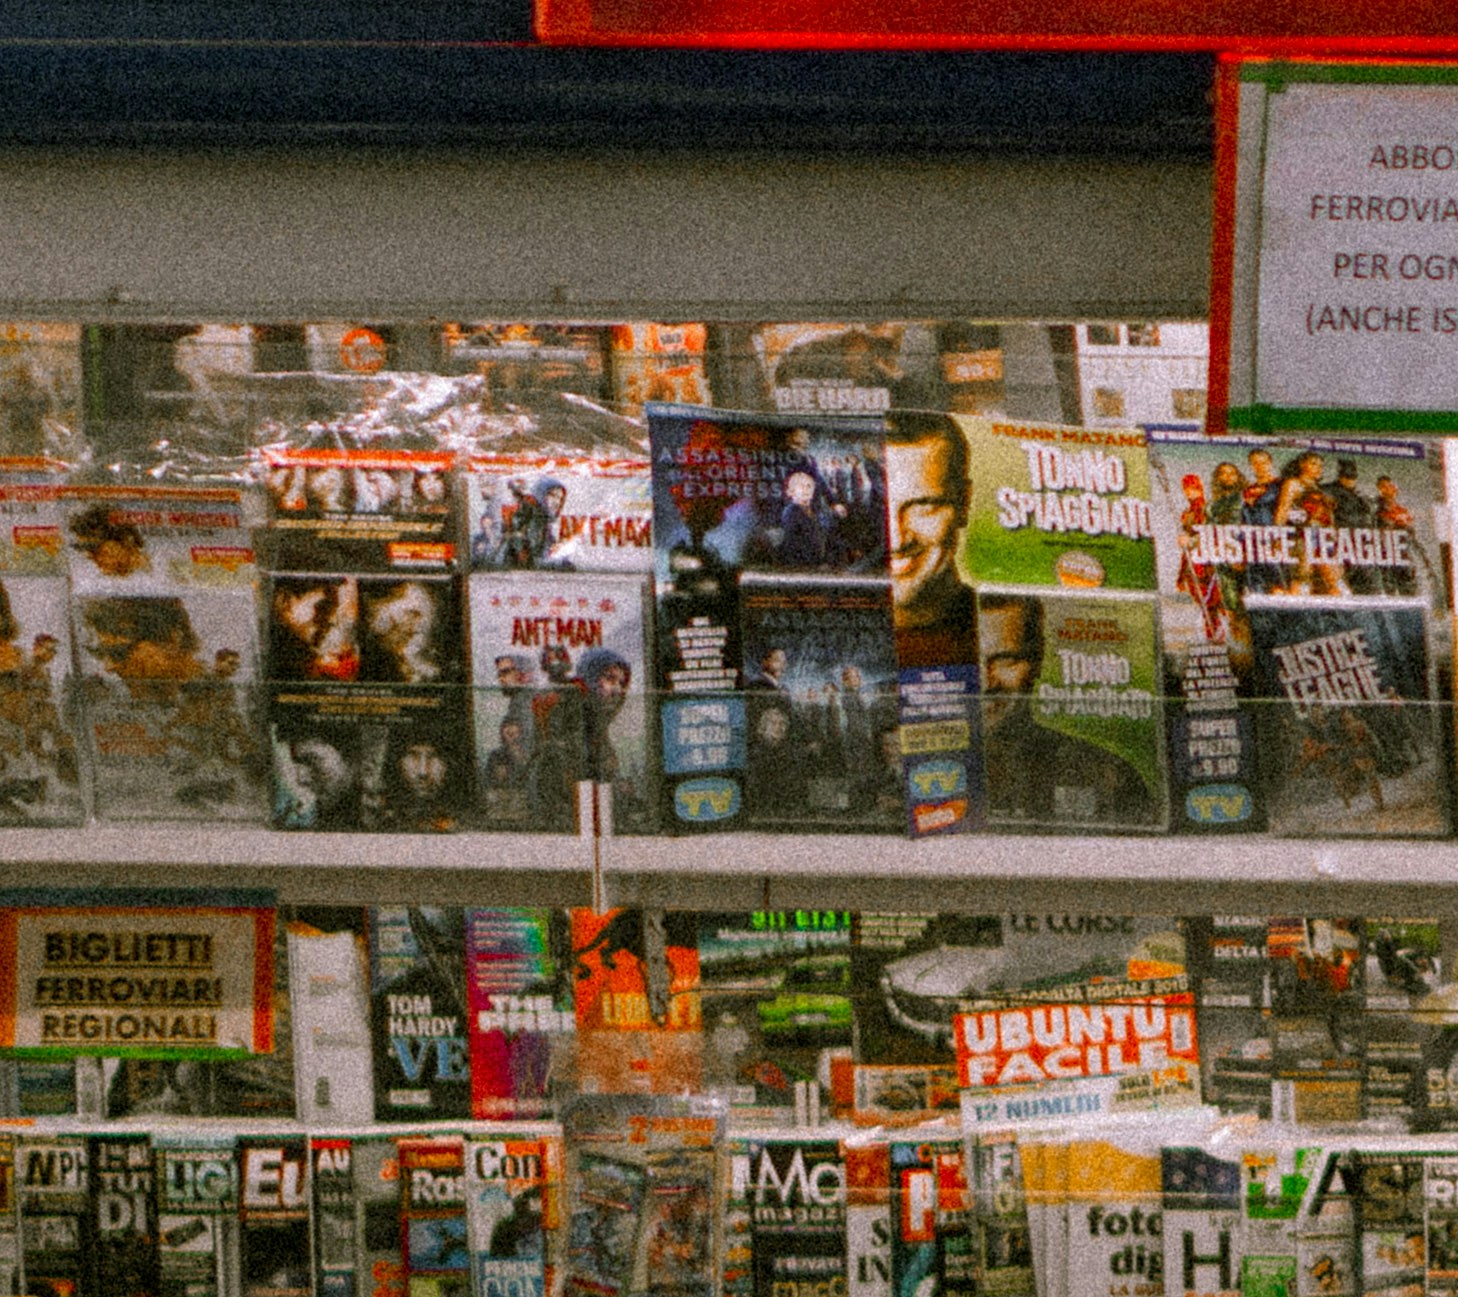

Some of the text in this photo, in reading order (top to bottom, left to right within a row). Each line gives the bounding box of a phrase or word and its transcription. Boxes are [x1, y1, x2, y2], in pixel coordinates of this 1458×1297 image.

[1333, 253, 1390, 280] PER
[1306, 303, 1420, 336] (ANCHE
[1190, 524, 1411, 568] JUSTICE LEAGUE
[43, 932, 213, 965] BIGLIETTI
[35, 976, 224, 1005] FERROVIARI
[41, 1014, 217, 1042] REGIONALI
[962, 998, 1168, 1054] UBUNTU
[967, 1040, 1170, 1087] FACILE
